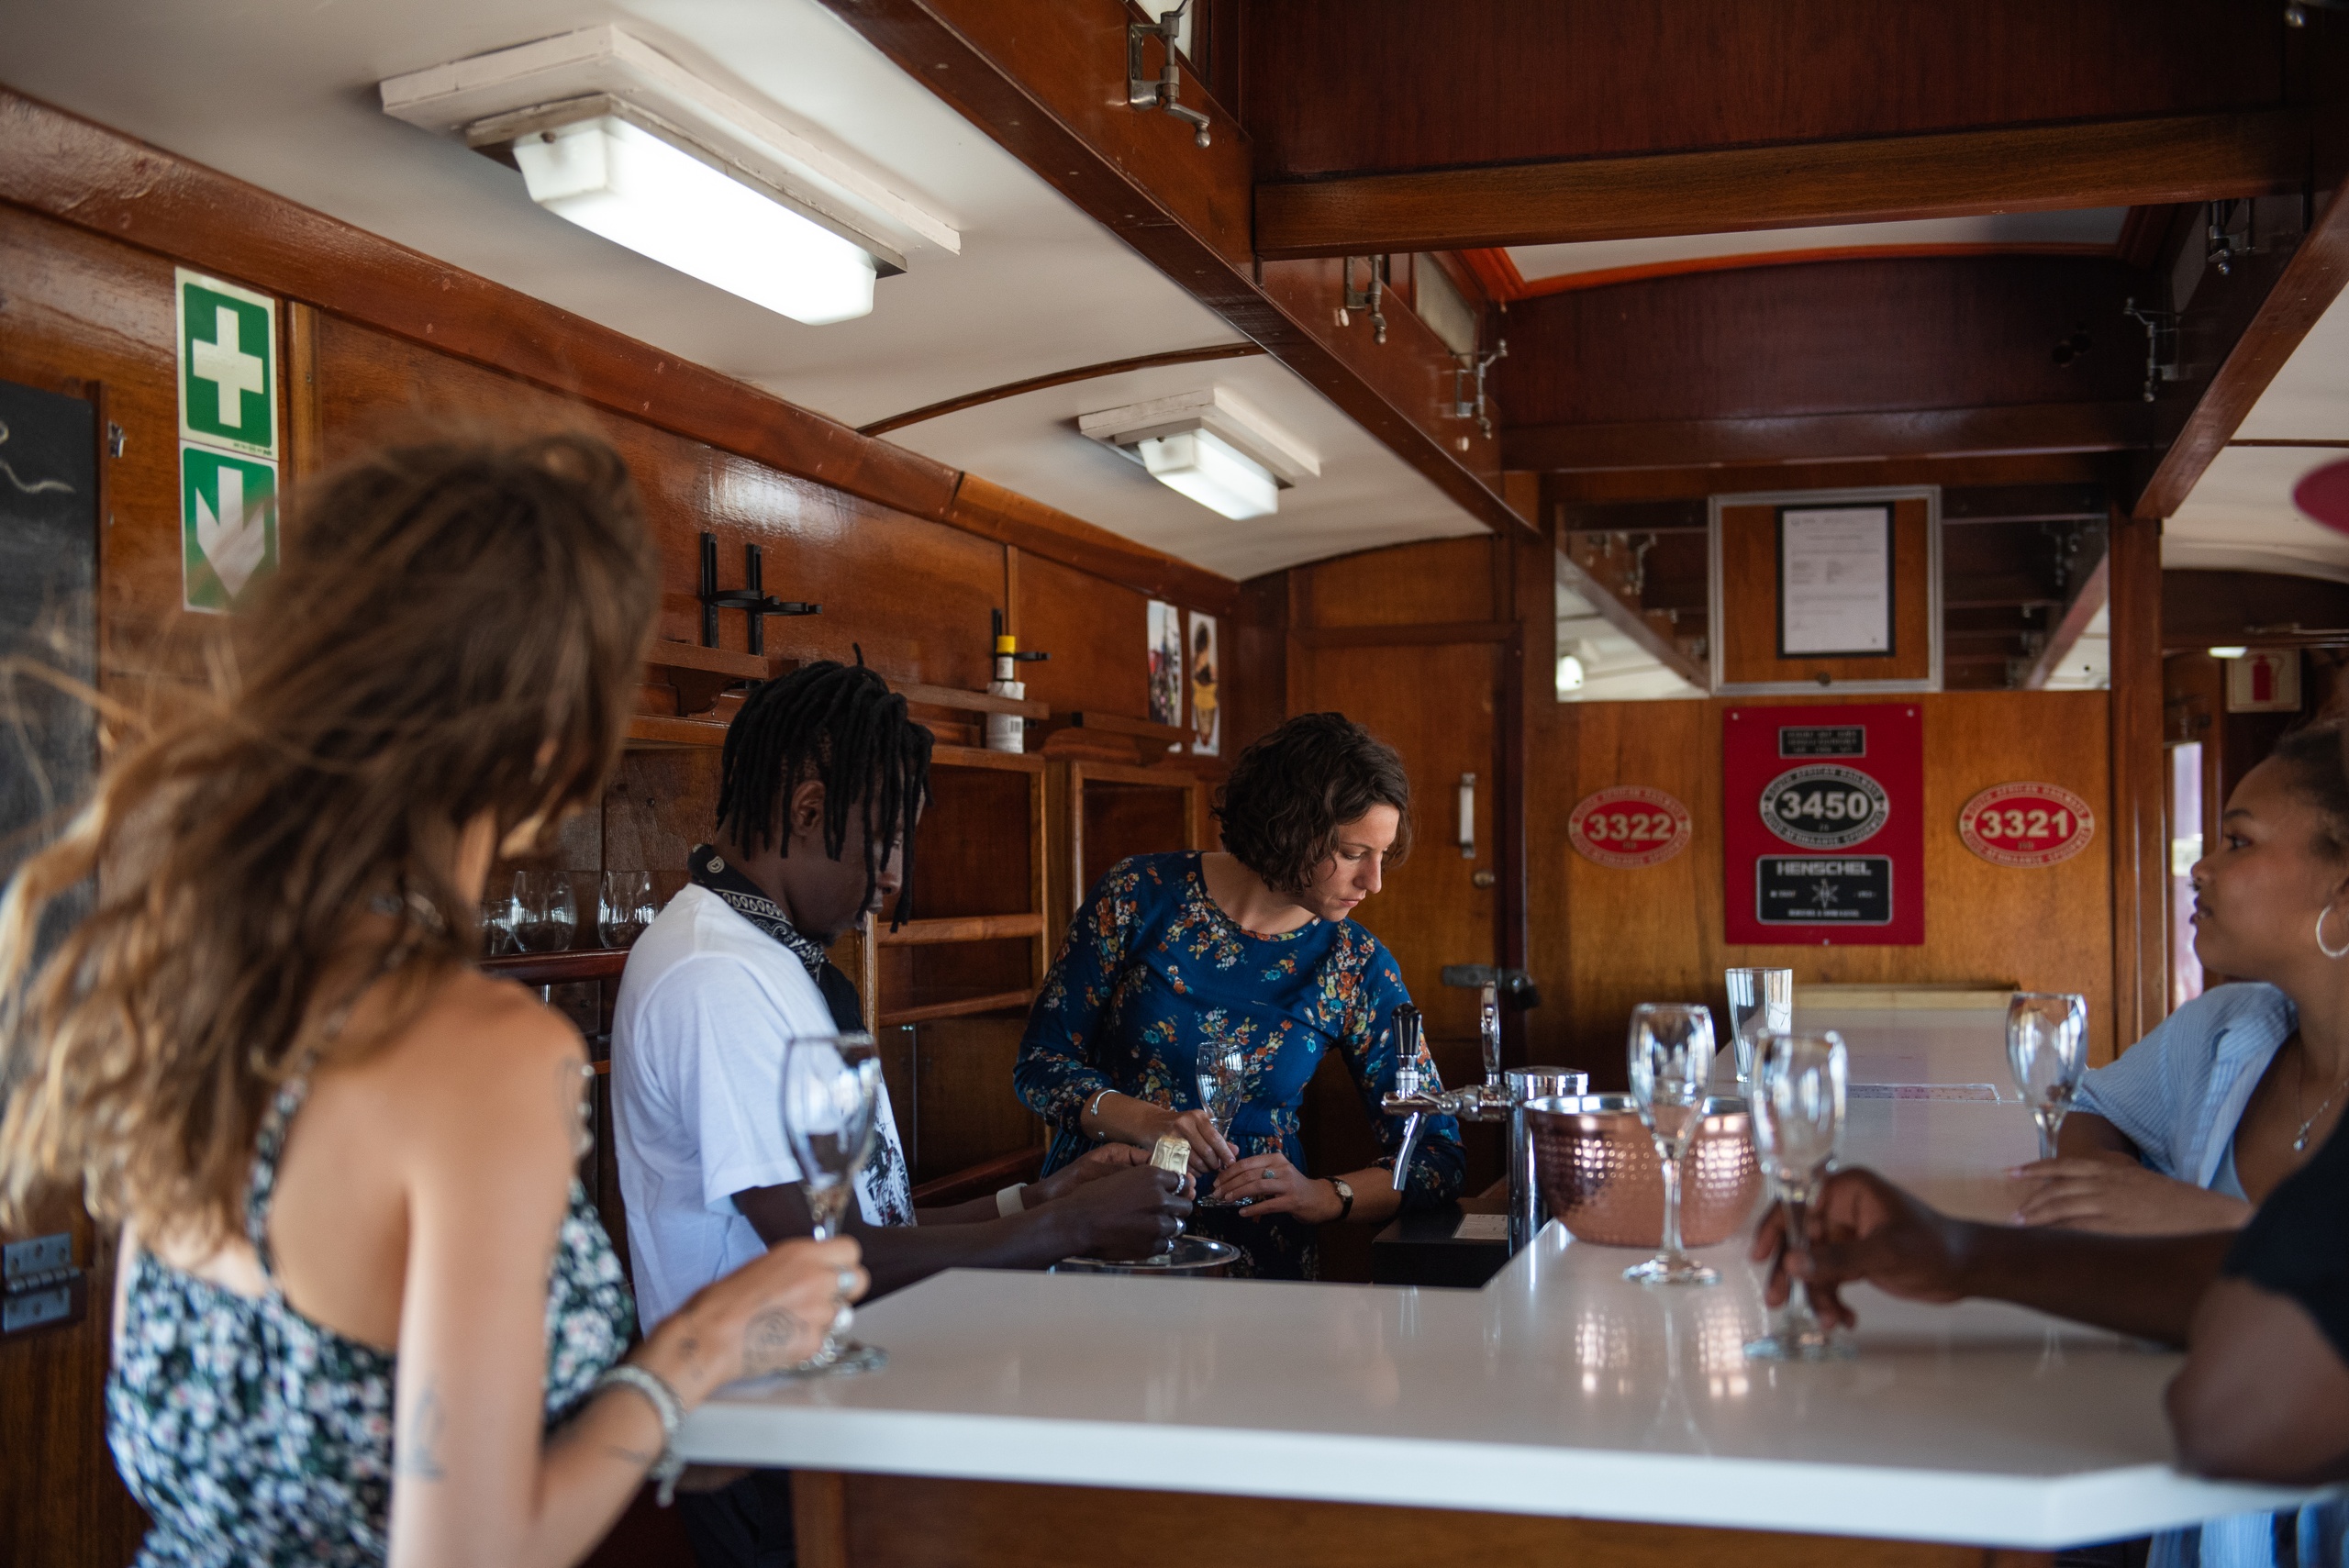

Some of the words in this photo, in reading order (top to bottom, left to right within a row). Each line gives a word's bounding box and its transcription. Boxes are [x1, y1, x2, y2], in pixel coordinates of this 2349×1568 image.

[1780, 790, 1869, 820] 3450
[1587, 813, 1672, 841] 3322
[1979, 808, 2068, 840] 3321
[1776, 861, 1872, 876] HENSCHEL
